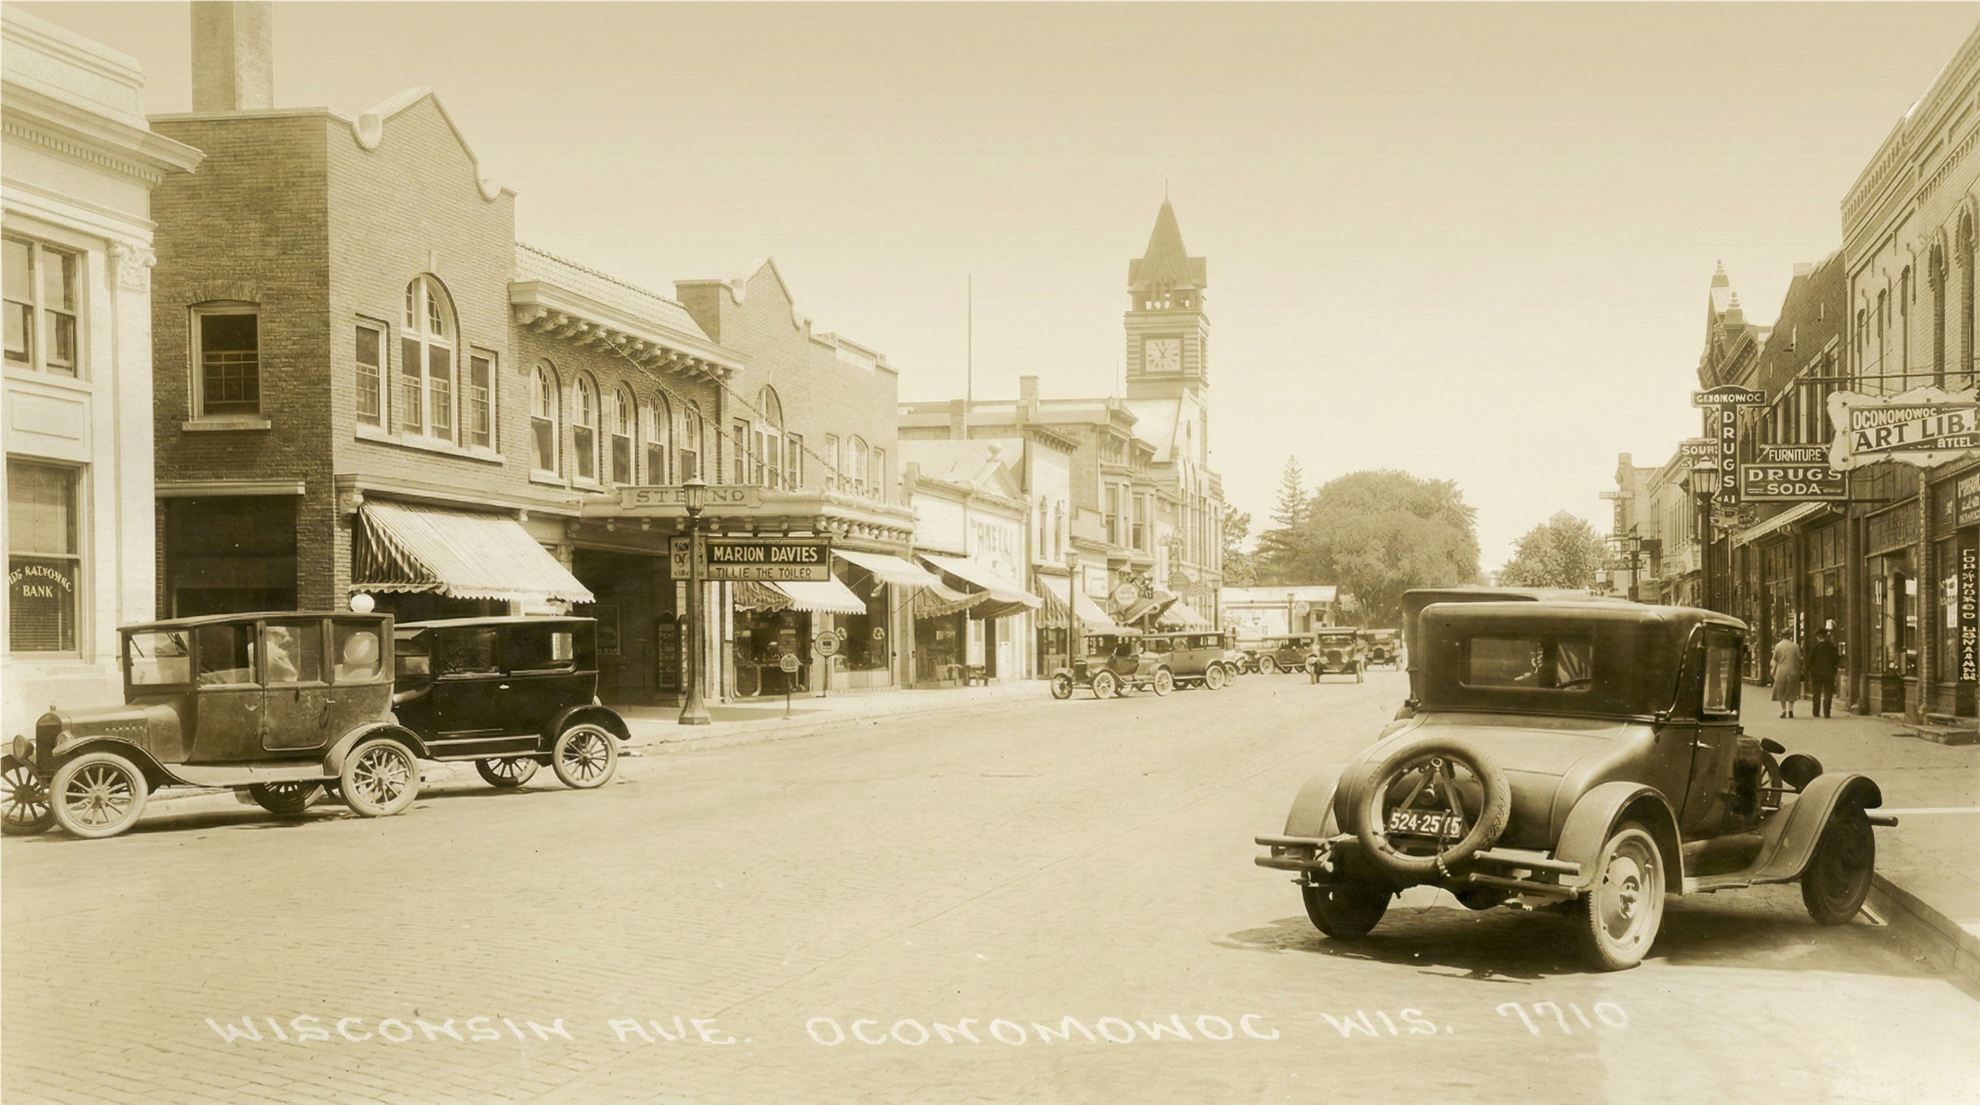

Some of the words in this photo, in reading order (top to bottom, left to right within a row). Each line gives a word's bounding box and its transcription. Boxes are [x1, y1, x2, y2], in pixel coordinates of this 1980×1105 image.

[1853, 407, 1938, 429] OCONOMOWOC
[1854, 423, 1910, 452] ART
[1921, 413, 1972, 439] LIB.
[1723, 411, 1735, 488] DRUGS
[1768, 449, 1822, 462] FURNITURE
[1748, 468, 1842, 481] DRUGS
[1766, 483, 1822, 495] SODA
[713, 546, 764, 562] MARION
[771, 546, 818, 562] DAVIES
[715, 567, 750, 578] TILLIE
[756, 567, 774, 579] THE
[779, 567, 812, 579] TOILER
[22, 585, 53, 598] BANK
